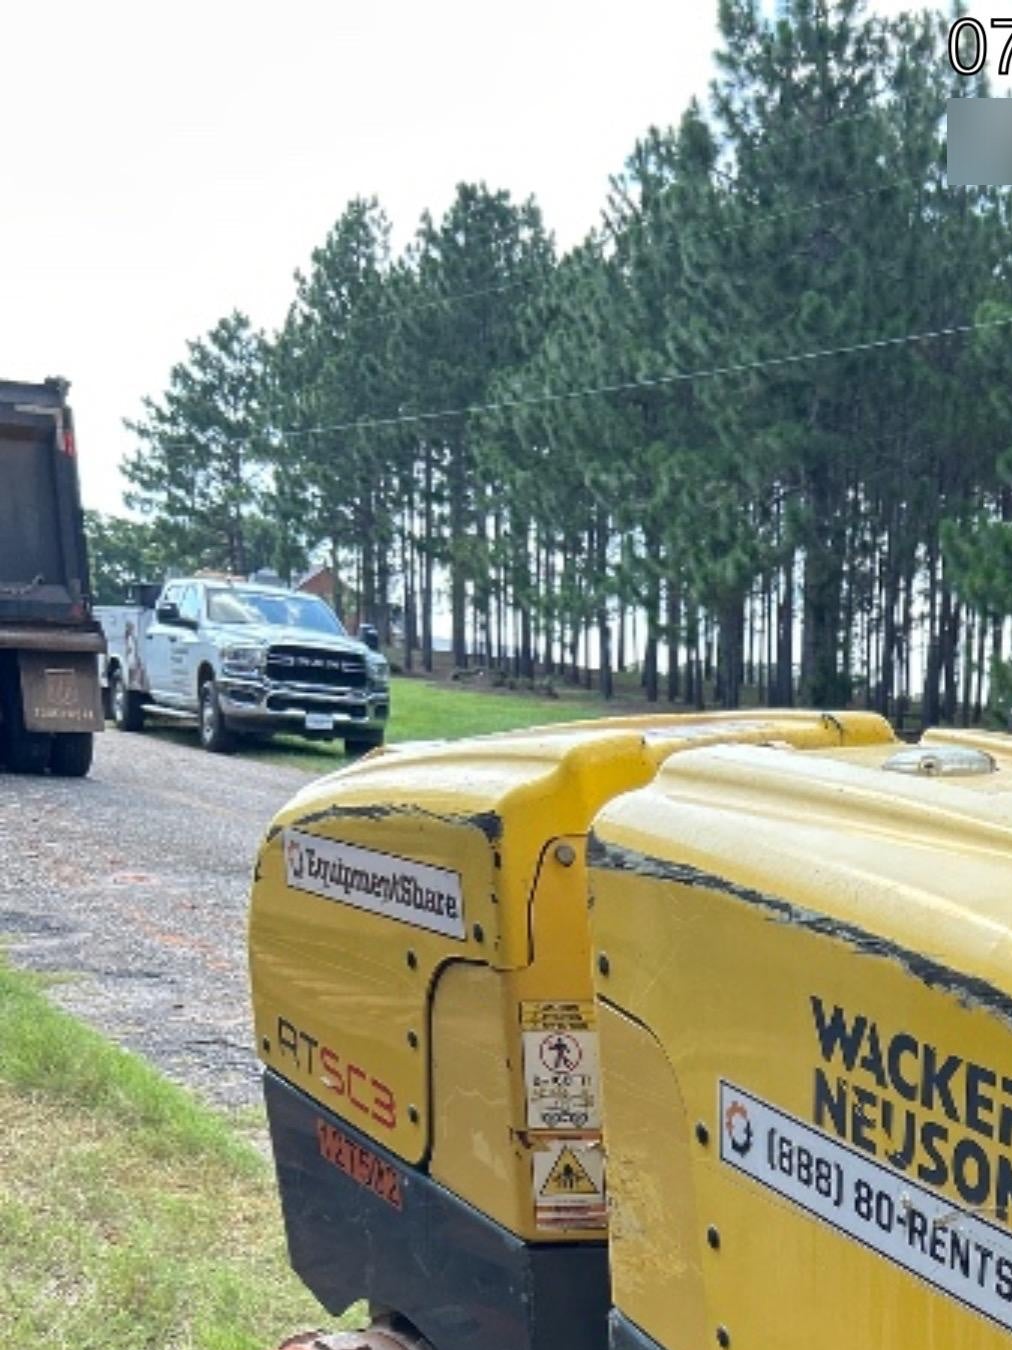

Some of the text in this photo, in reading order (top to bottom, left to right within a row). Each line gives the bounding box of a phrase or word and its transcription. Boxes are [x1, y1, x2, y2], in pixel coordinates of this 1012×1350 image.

[296, 656, 340, 669] RAM
[305, 848, 459, 919] EquipmentShare
[766, 1127, 845, 1207] (888)
